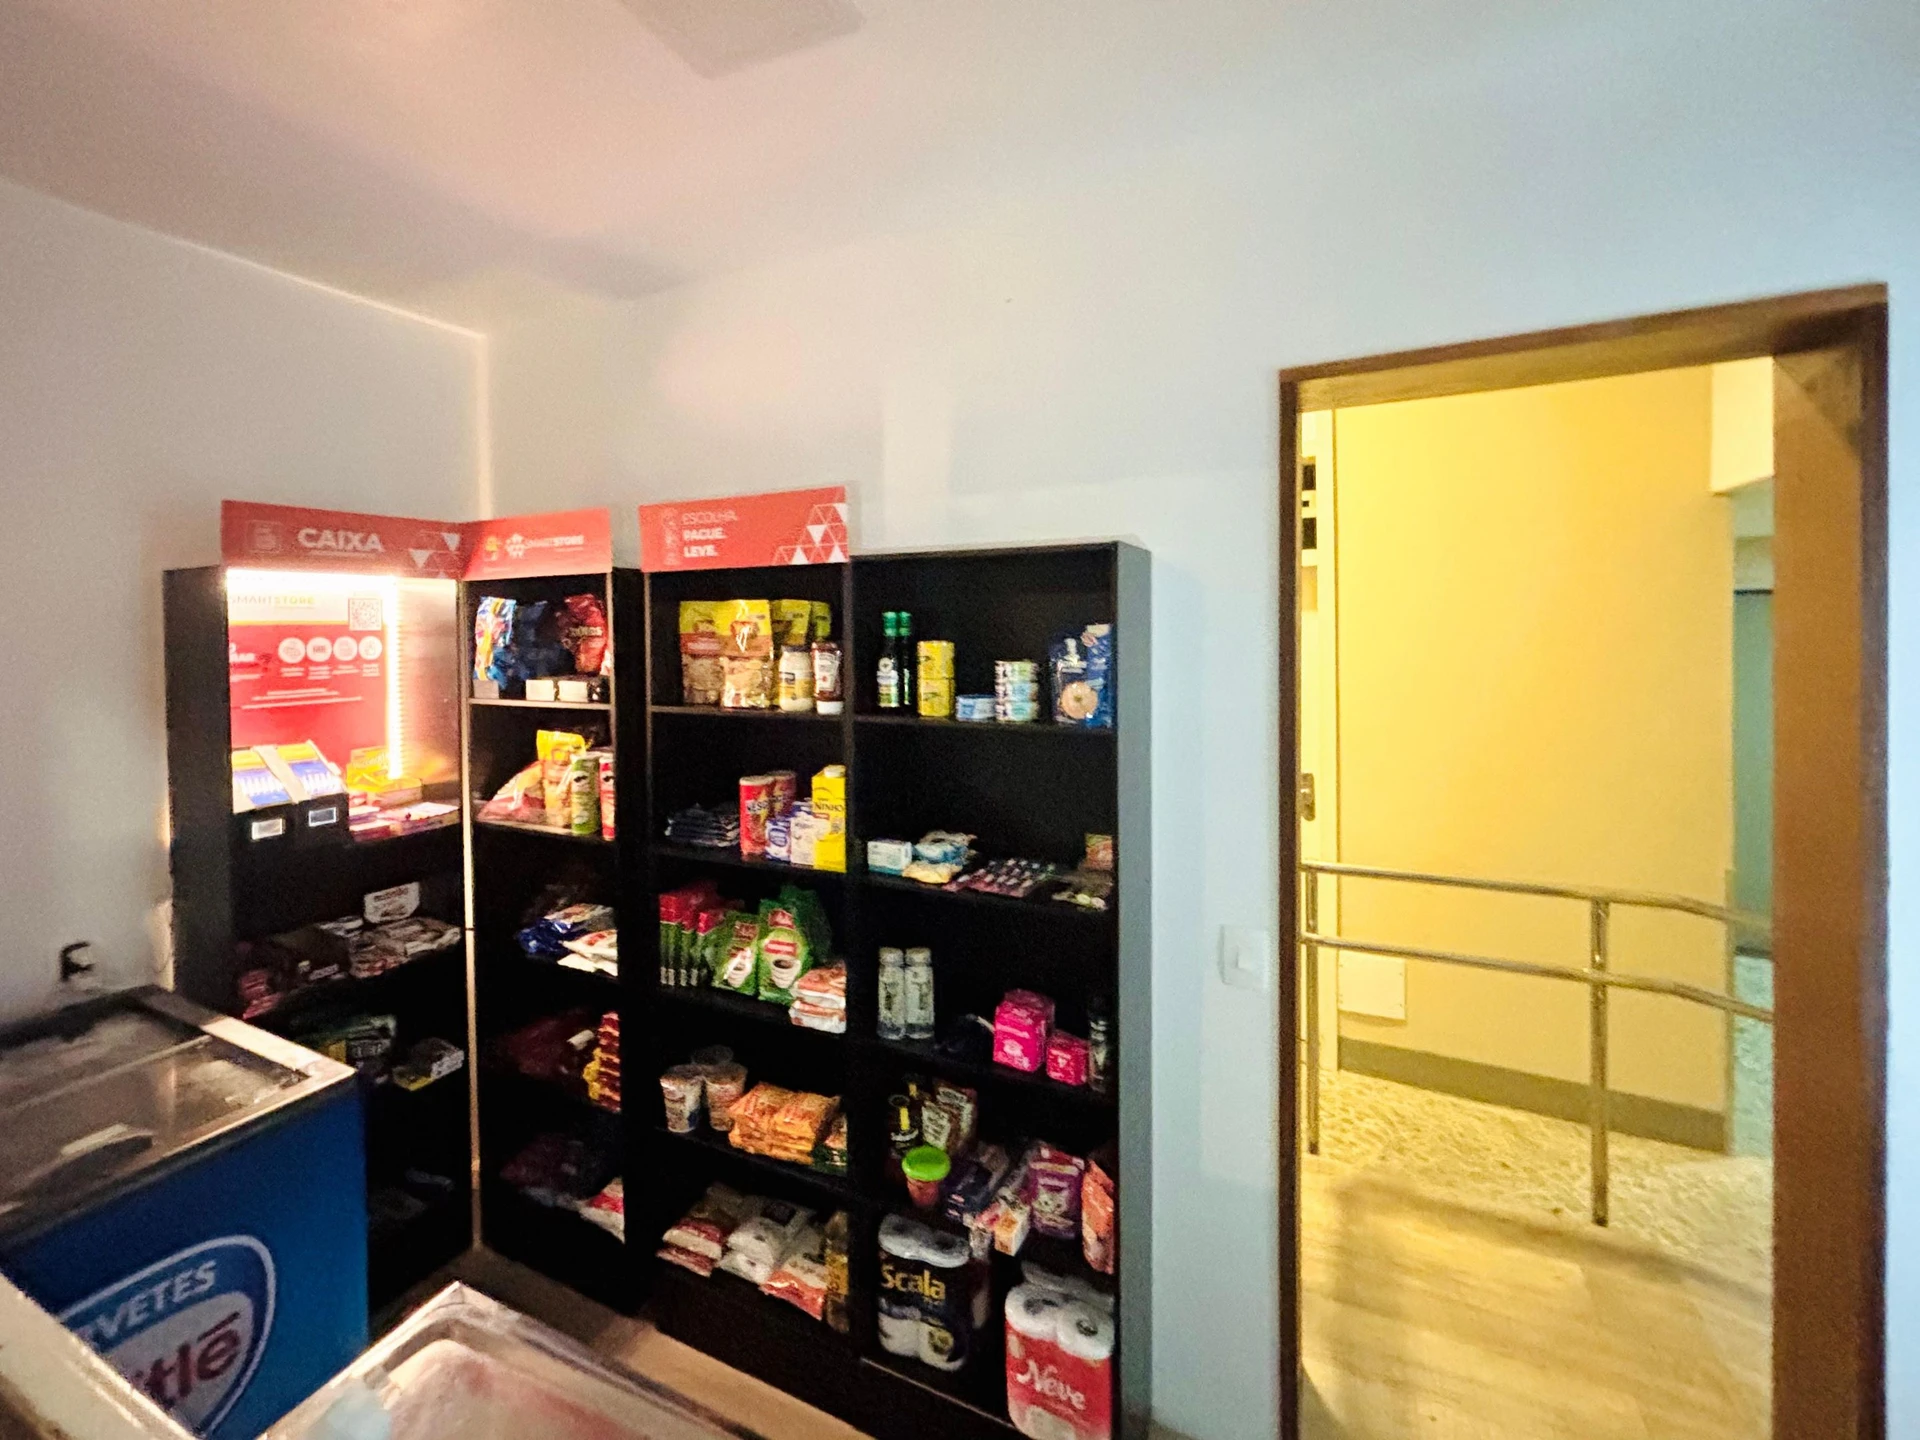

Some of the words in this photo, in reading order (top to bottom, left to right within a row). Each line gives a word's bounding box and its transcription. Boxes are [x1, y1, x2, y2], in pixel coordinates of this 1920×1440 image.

[297, 527, 386, 553] CAIXA
[881, 1264, 946, 1300] Scala
[1016, 1358, 1086, 1411] Neve
